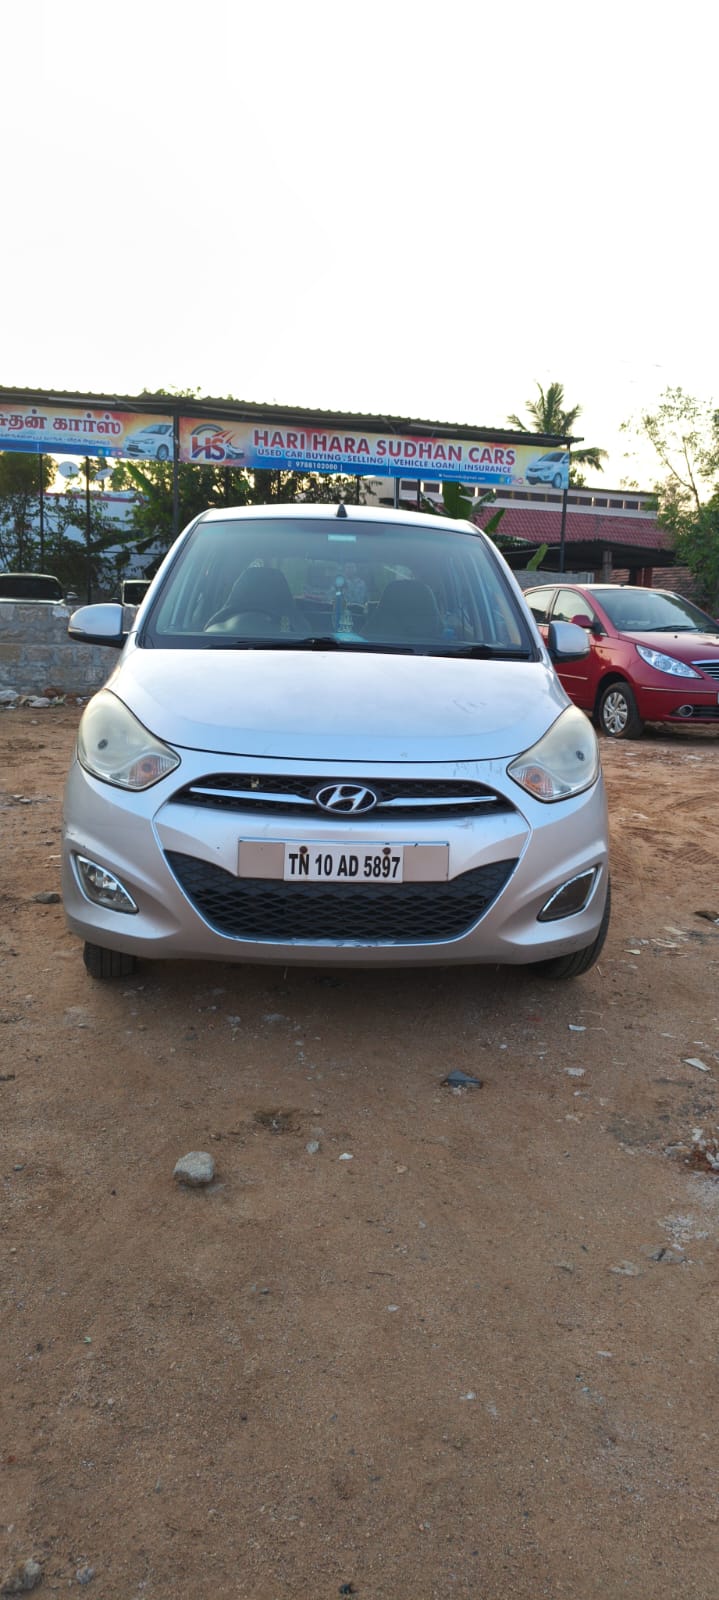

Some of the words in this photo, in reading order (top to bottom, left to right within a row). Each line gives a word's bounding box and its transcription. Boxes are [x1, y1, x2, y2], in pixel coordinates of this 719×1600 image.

[53, 412, 121, 434] கார்ஸ்
[191, 436, 226, 460] HS
[254, 429, 305, 449] HARI
[313, 434, 370, 454] HARA
[376, 439, 462, 462] SUDHAN
[468, 447, 515, 466] CARS
[257, 449, 282, 457] USED
[306, 452, 341, 461] BUYING
[347, 455, 384, 464] SELLING
[393, 458, 429, 467] VEHICLE
[431, 461, 455, 469] LOAN
[464, 464, 512, 473] INSURANCE
[289, 853, 309, 875] TN
[315, 853, 333, 876] 10
[337, 855, 359, 876] AD
[363, 855, 401, 878] 5897
